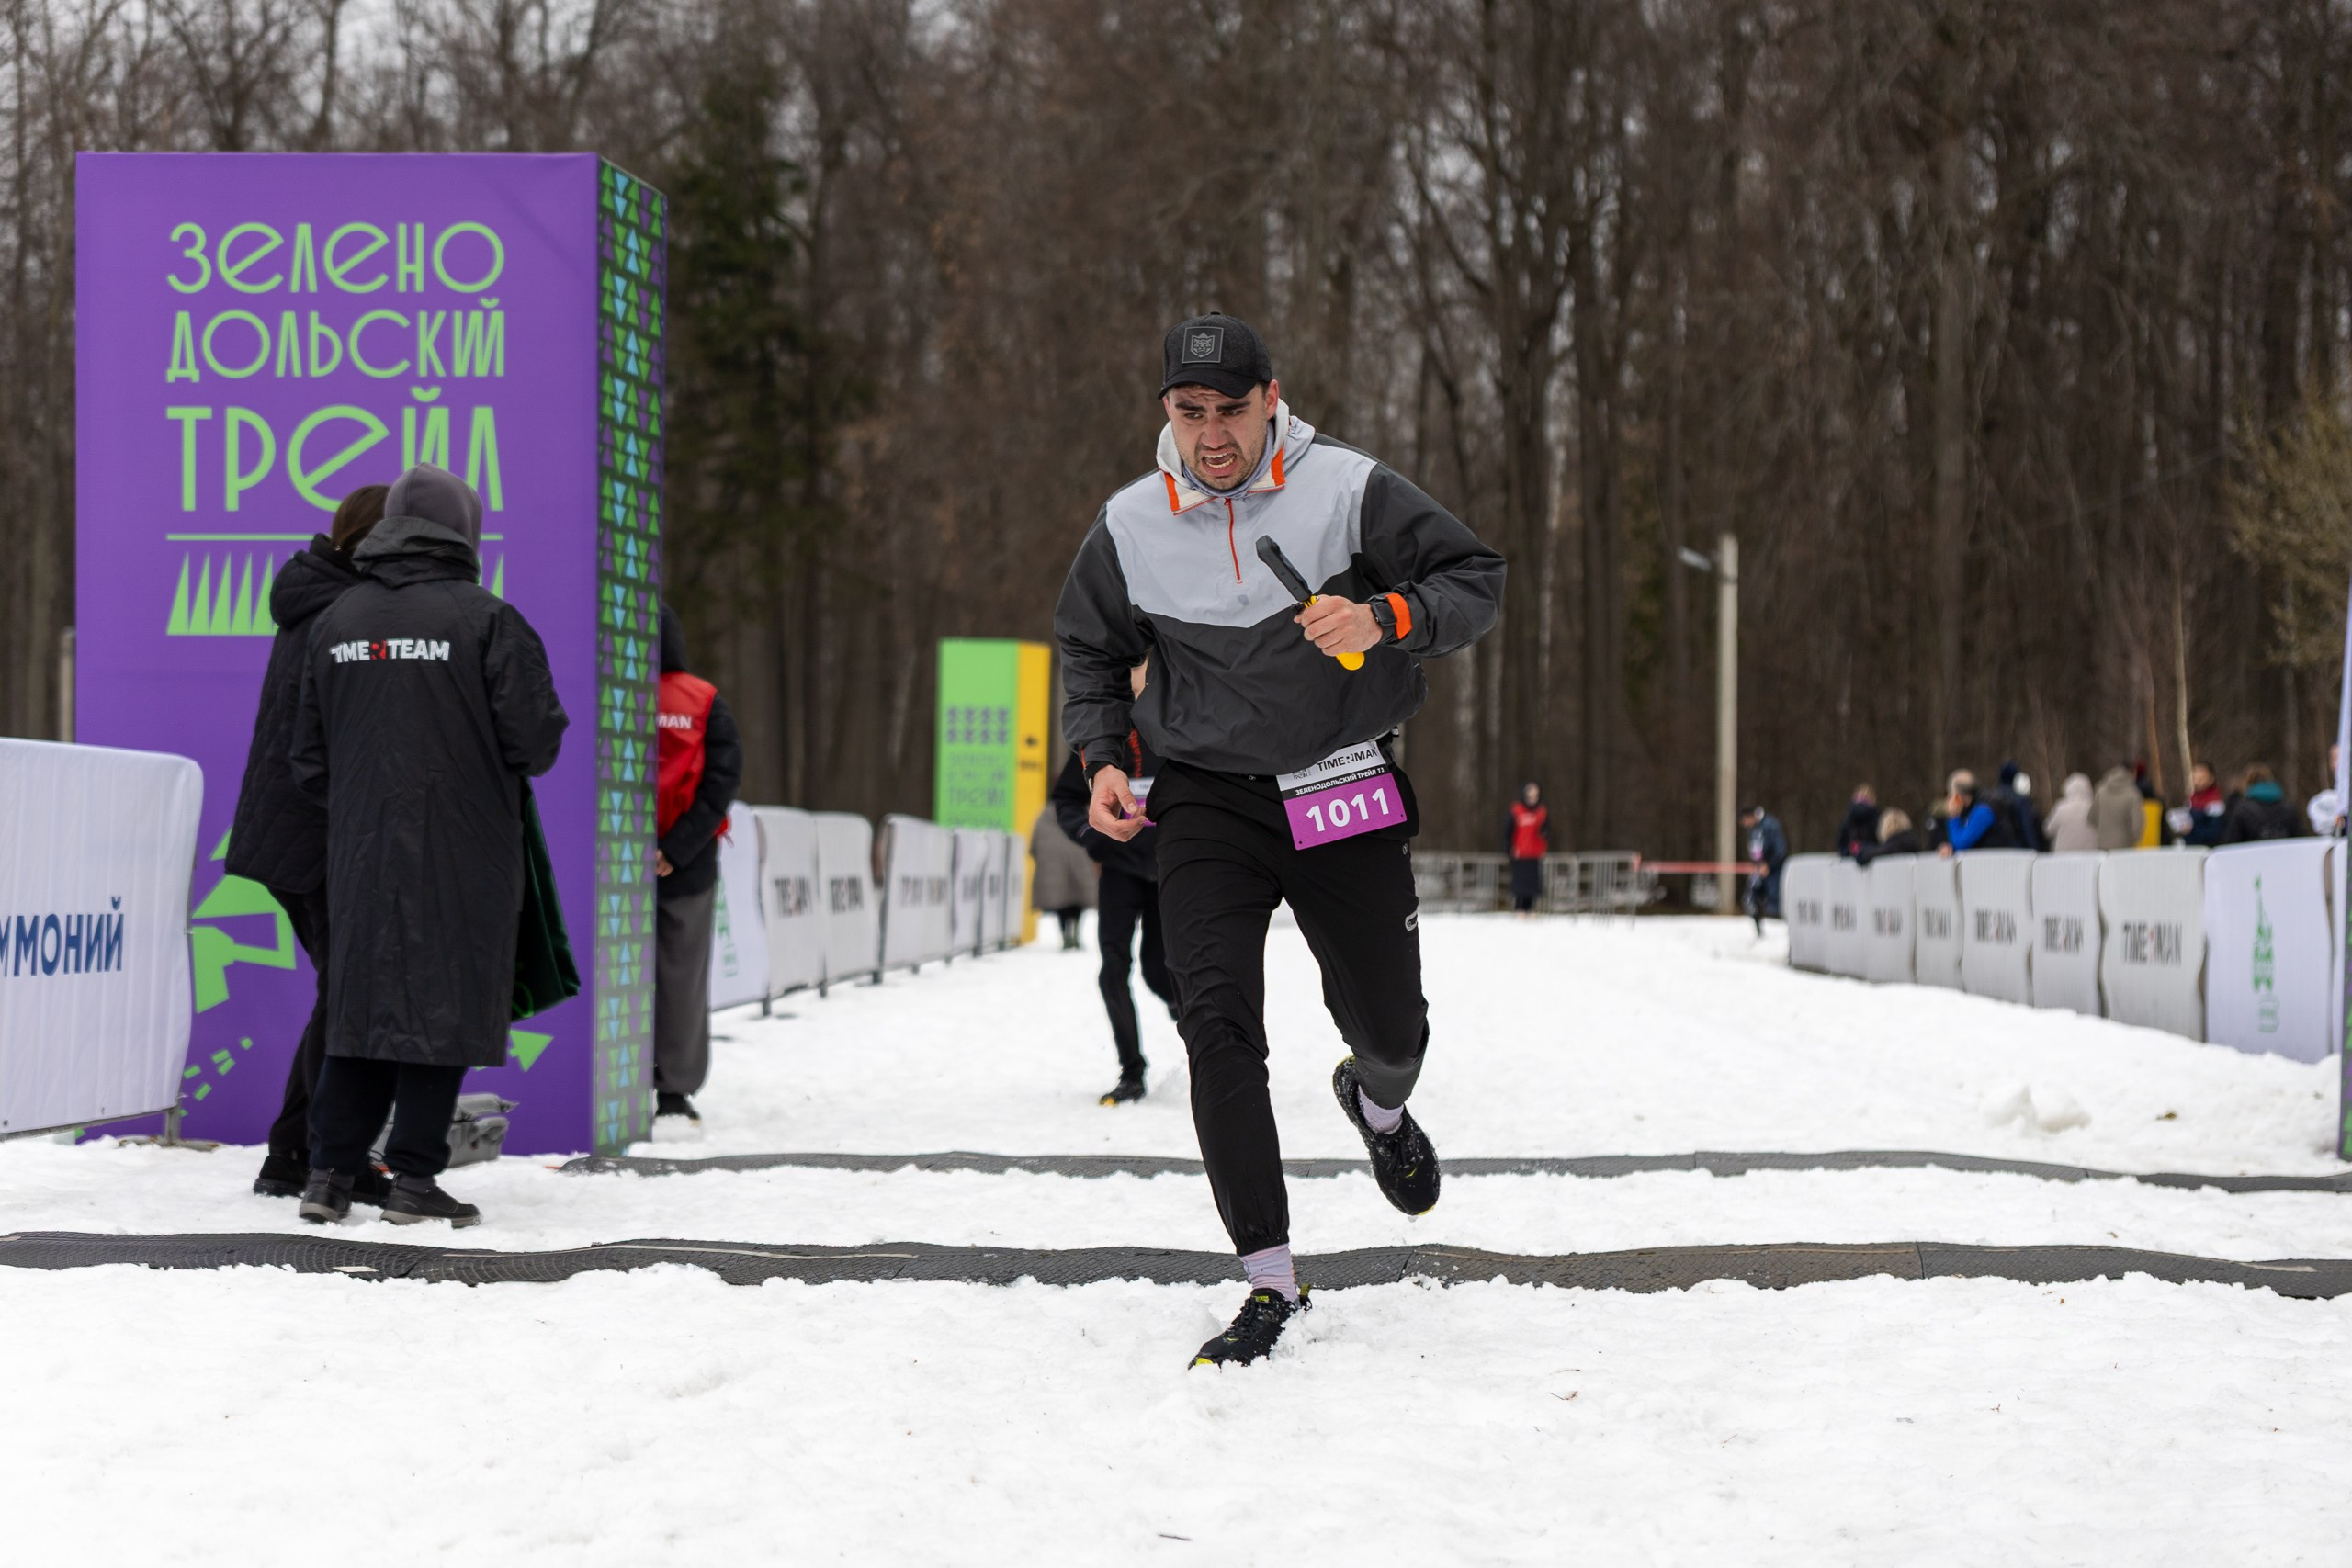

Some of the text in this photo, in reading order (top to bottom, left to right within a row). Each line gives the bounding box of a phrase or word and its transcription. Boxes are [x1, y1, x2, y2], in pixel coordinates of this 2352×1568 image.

[165, 297, 504, 383] ДОЛЬСКИЙ
[1295, 773, 1357, 795] ЗЕЛЕНОДОЛЬСКИЙ
[1357, 768, 1377, 779] ТРЕЙЛ
[1306, 787, 1389, 832] 1011
